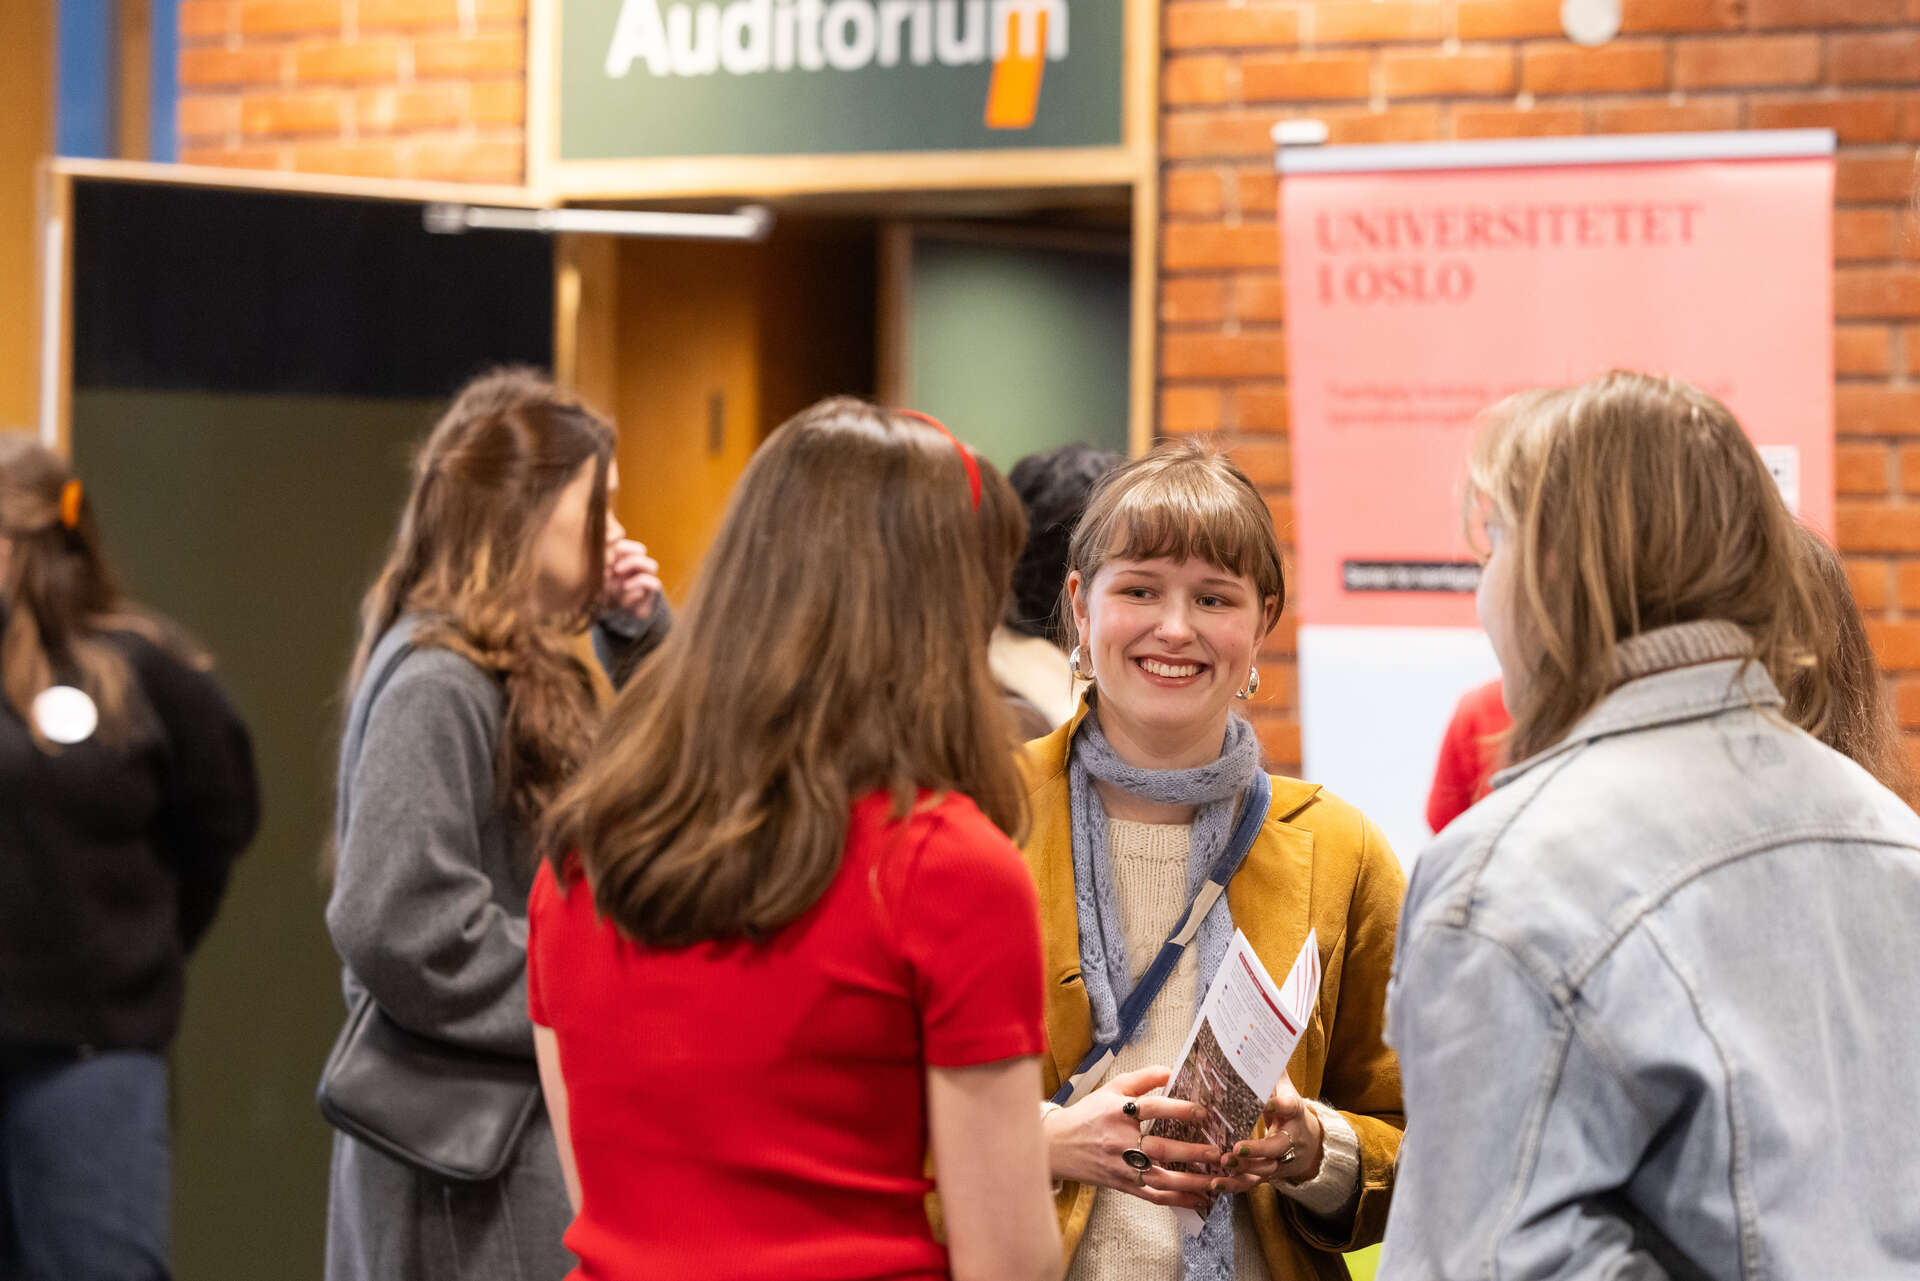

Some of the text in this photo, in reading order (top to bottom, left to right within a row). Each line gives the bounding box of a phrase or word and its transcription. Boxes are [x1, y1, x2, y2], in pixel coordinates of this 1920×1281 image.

[605, 0, 1068, 77] Auditorium
[1317, 203, 1700, 251] UNIVERSITETET
[1317, 262, 1473, 304] I OSLO
